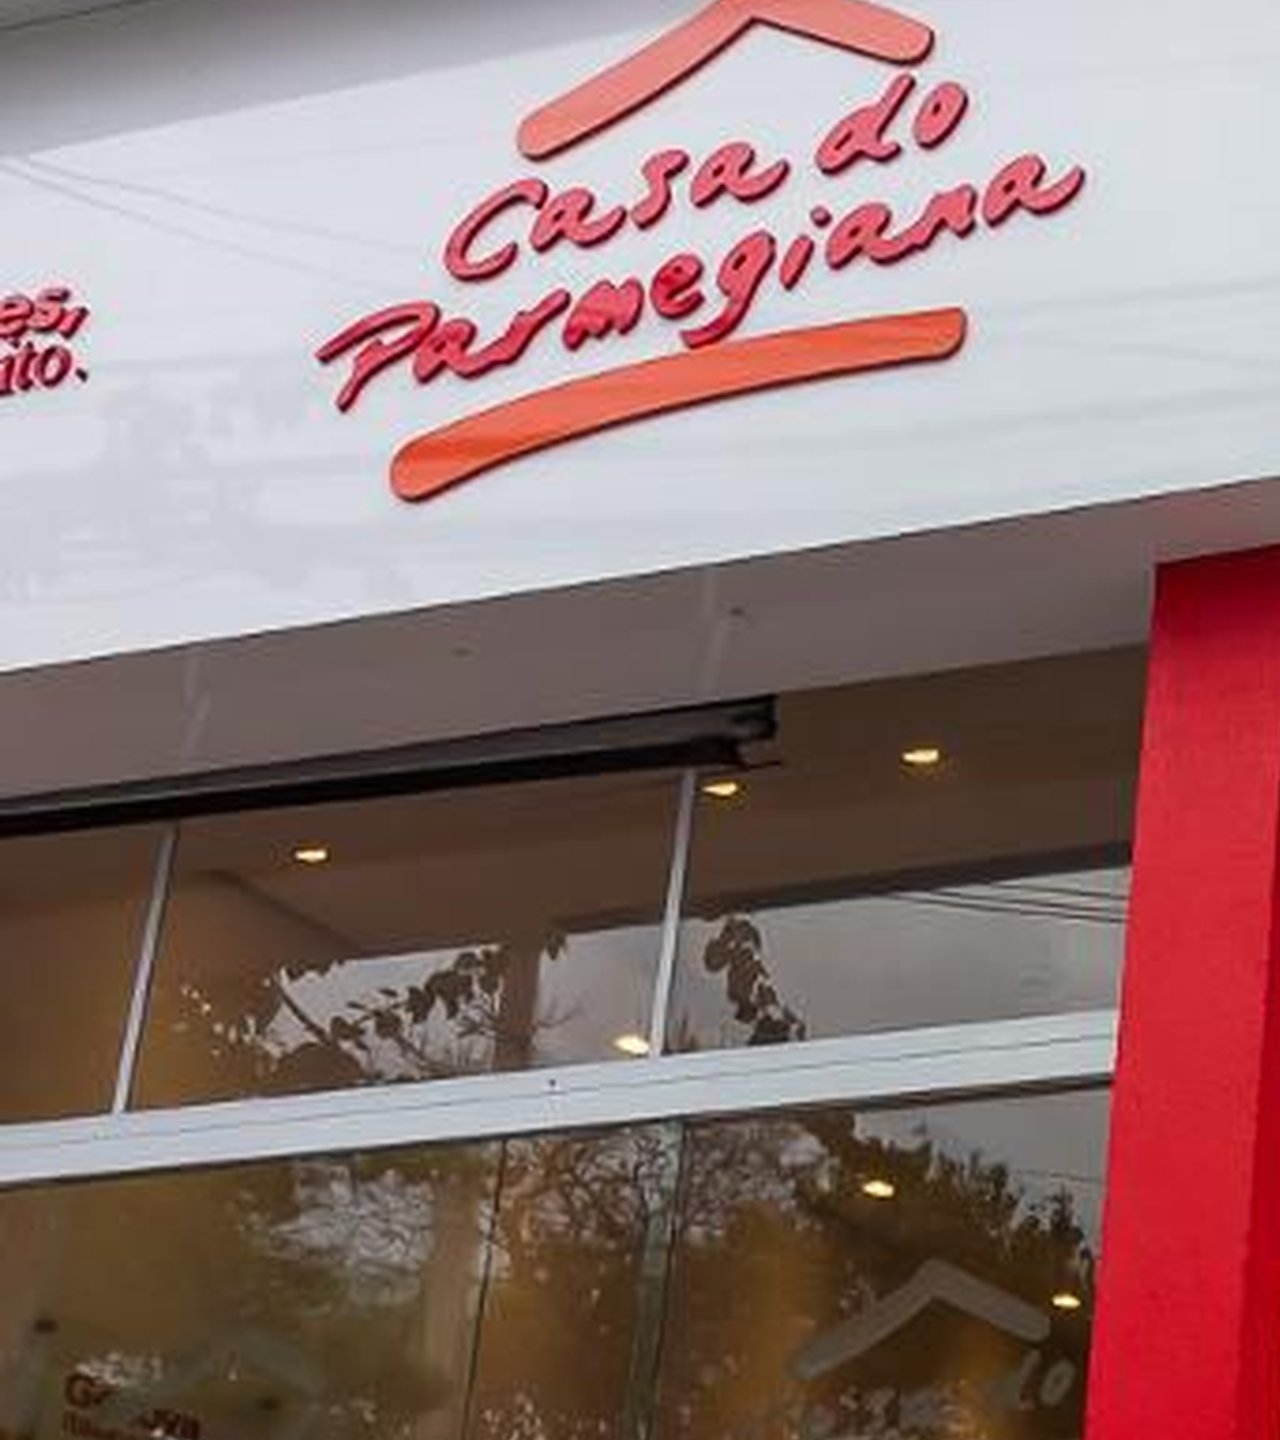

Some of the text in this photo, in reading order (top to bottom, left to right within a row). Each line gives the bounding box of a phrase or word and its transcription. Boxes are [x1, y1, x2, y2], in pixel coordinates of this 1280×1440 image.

[313, 154, 1085, 413] Parmegiana
[441, 72, 970, 282] Casa do
